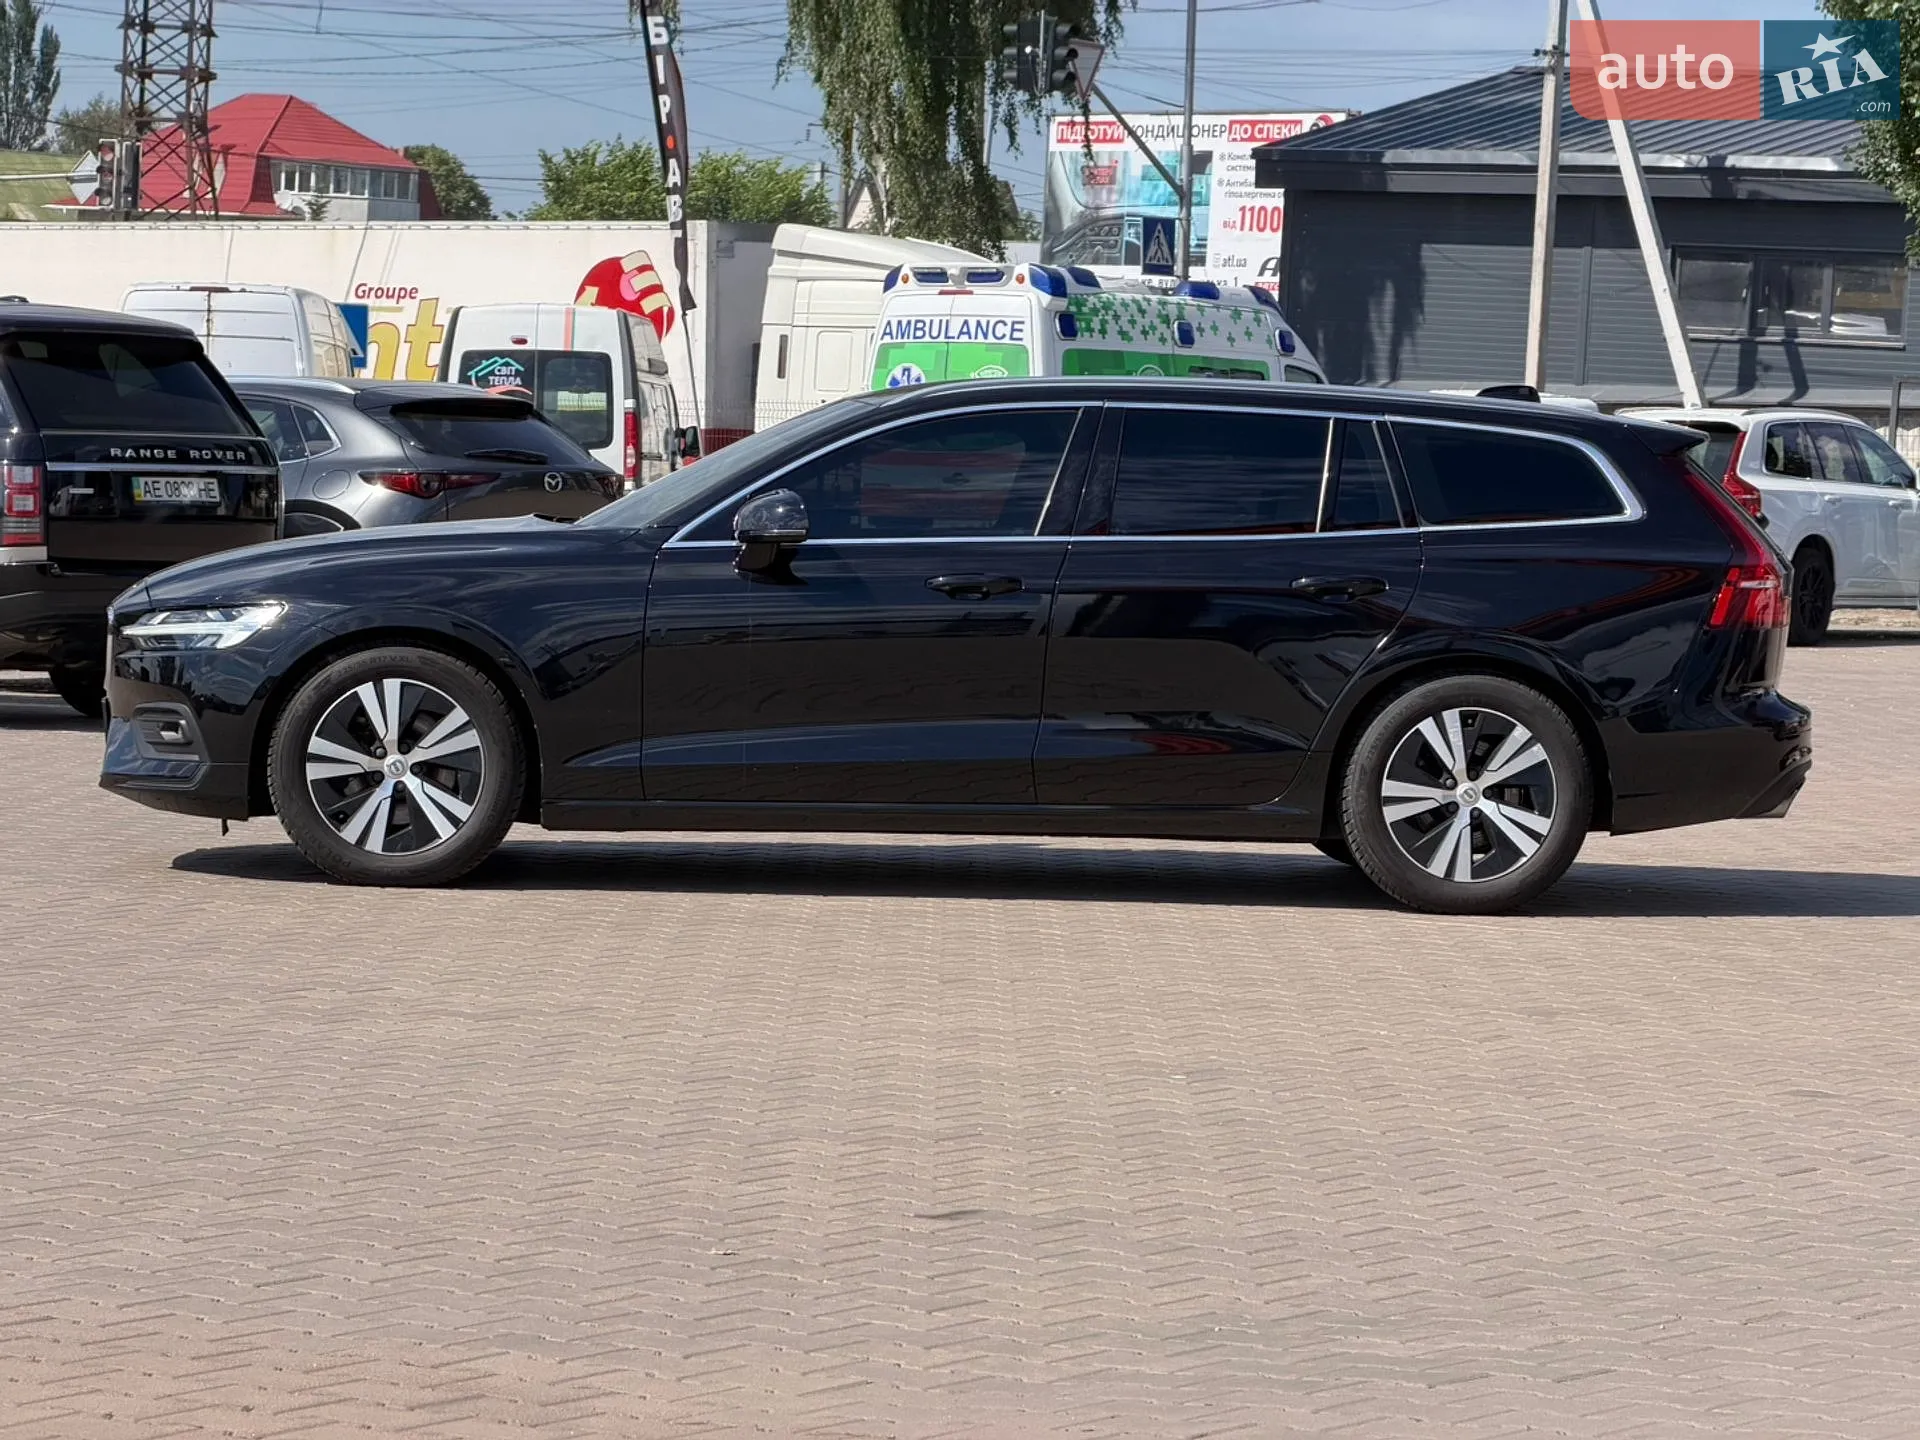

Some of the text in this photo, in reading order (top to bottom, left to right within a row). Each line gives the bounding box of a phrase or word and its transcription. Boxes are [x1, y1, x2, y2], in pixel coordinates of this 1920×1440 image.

[645, 8, 672, 125] БІР
[1057, 122, 1125, 142] ПІДОТУЙ
[1127, 124, 1227, 141] ОНДИЦОНЕР
[1230, 124, 1252, 142] ДО
[1222, 205, 1282, 233] від 1100
[1221, 254, 1248, 268] atl.ua
[354, 282, 419, 305] Groupe
[880, 318, 1026, 342] AMBULANCE
[488, 376, 522, 386] ТЕПЛА
[110, 447, 246, 461] RANGE ROVER
[143, 480, 163, 499] AE
